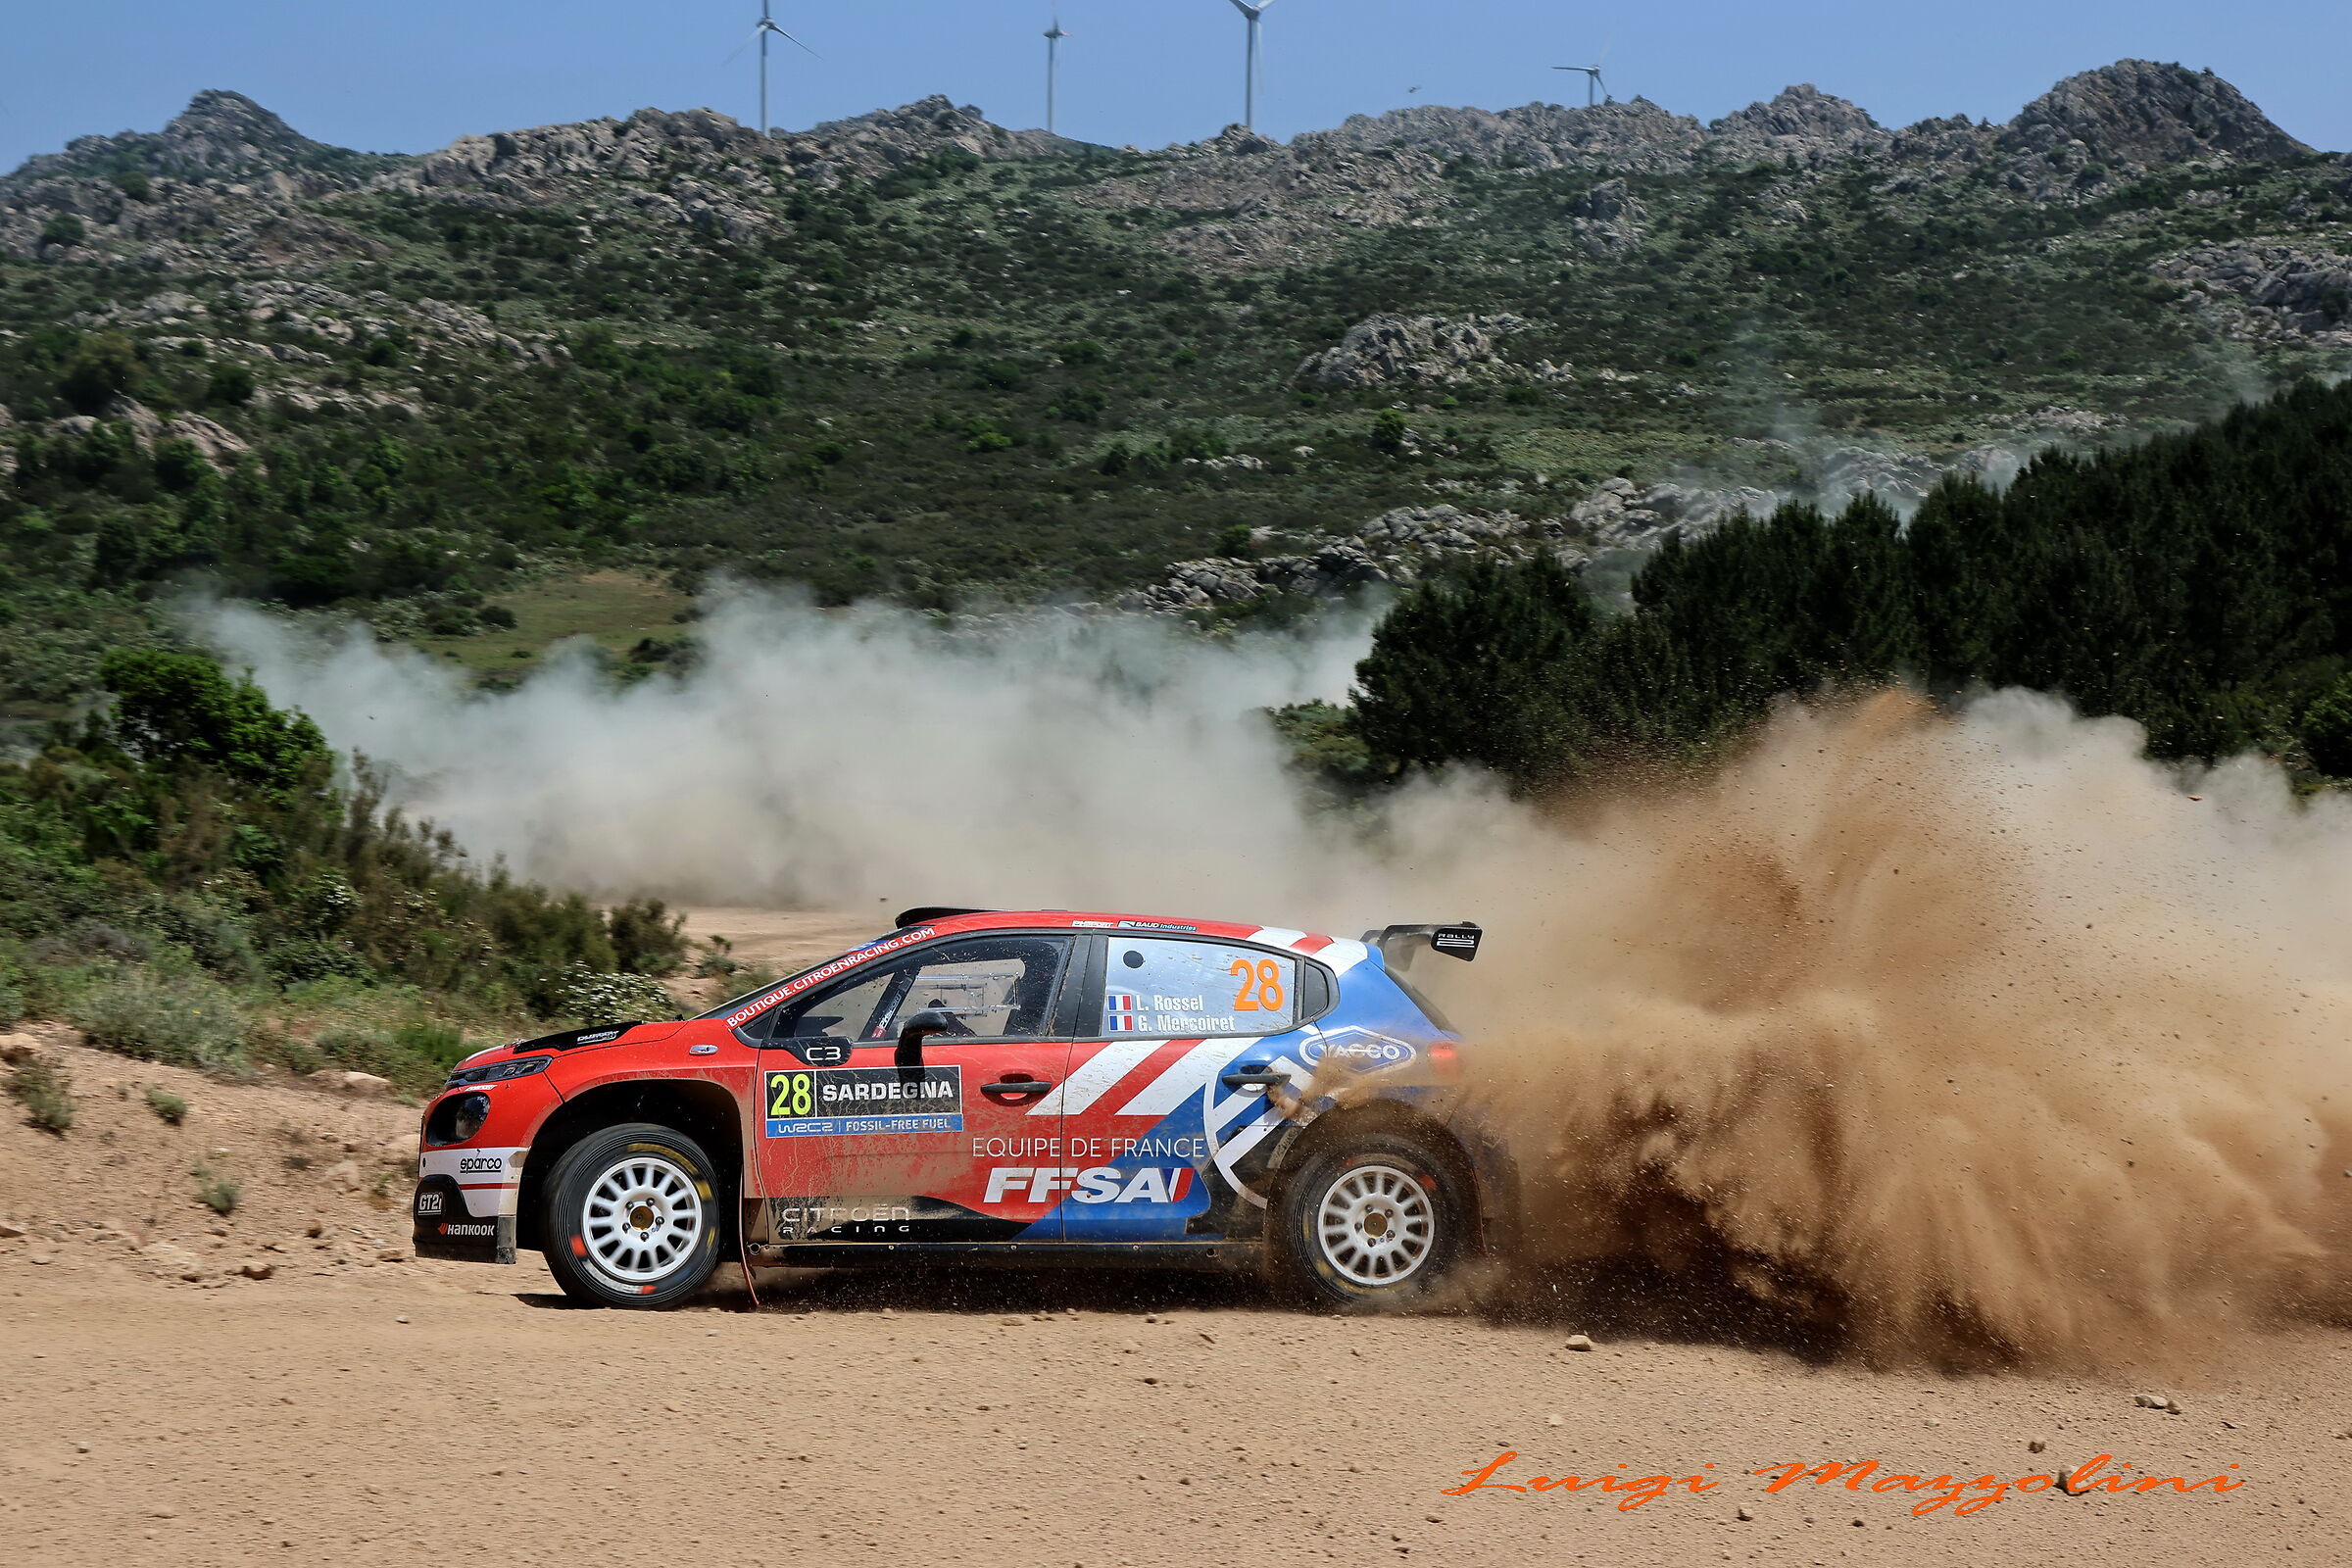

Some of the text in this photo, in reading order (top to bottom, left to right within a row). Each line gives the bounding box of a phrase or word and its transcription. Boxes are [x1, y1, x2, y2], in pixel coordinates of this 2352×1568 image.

[1160, 923, 1197, 932] Industries
[726, 927, 935, 1027] BOUTIQUE.CITROËNRACING.COM
[1230, 958, 1284, 1011] 28
[1136, 995, 1203, 1011] L. Rossel
[1138, 1014, 1235, 1032] G. Mercoiret
[806, 1046, 842, 1060] C3
[770, 1073, 811, 1116] 28
[822, 1081, 954, 1102] SARDEGNA
[778, 1118, 951, 1134] WRC2 FOSSIL-FREE FUEL
[972, 1138, 1204, 1158] EQUIPE DE FRANCE
[460, 1157, 502, 1174] sparco
[983, 1166, 1169, 1203] FFSA
